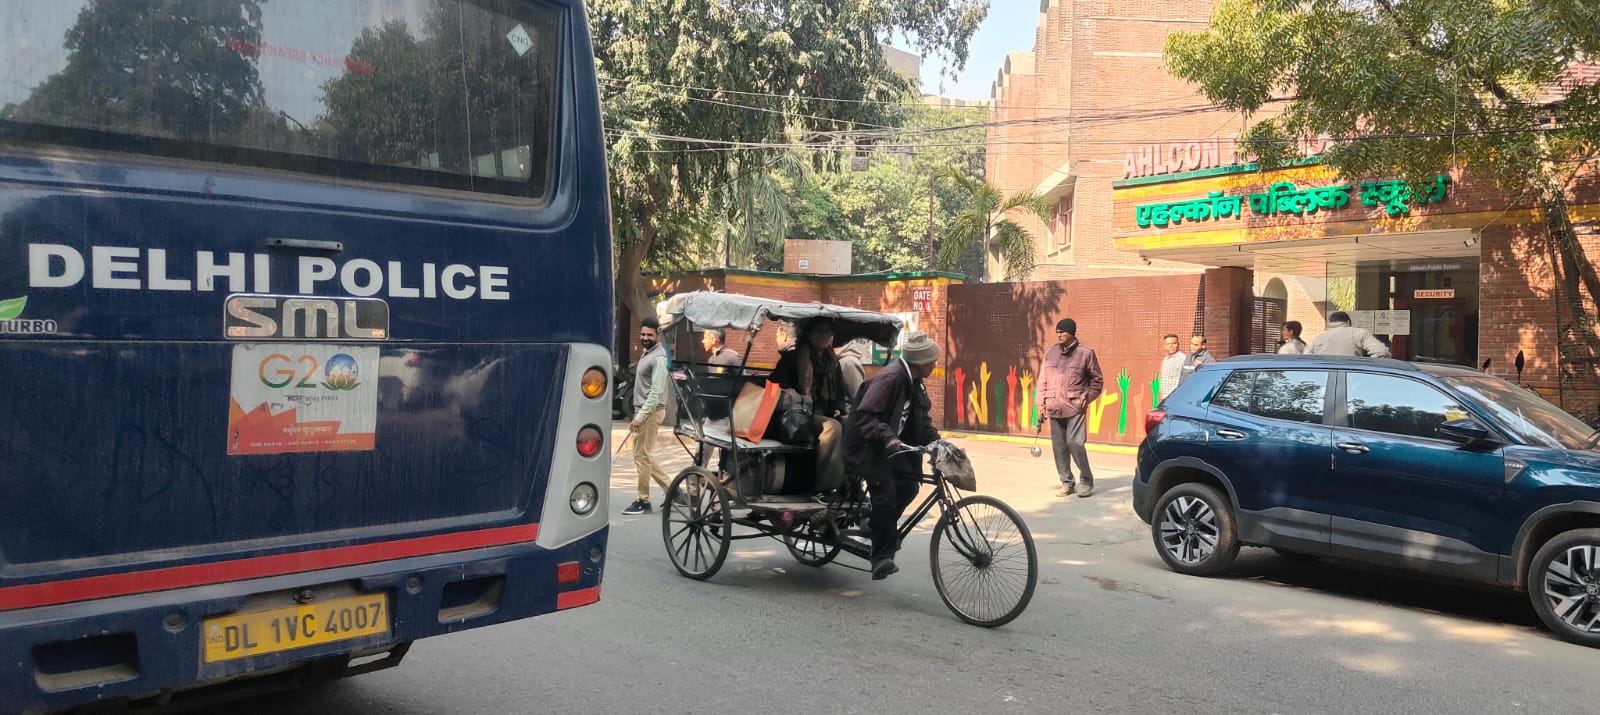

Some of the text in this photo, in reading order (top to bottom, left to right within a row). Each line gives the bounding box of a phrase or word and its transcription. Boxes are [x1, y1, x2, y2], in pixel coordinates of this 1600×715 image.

[1123, 136, 1220, 179] AHLCON
[1249, 181, 1352, 215] पब्लिक
[28, 243, 510, 300] DELHI POLICE
[913, 290, 931, 300] GATE
[227, 298, 385, 338] SML
[258, 353, 361, 391] G20
[225, 602, 381, 652] DL 1VC 4007
